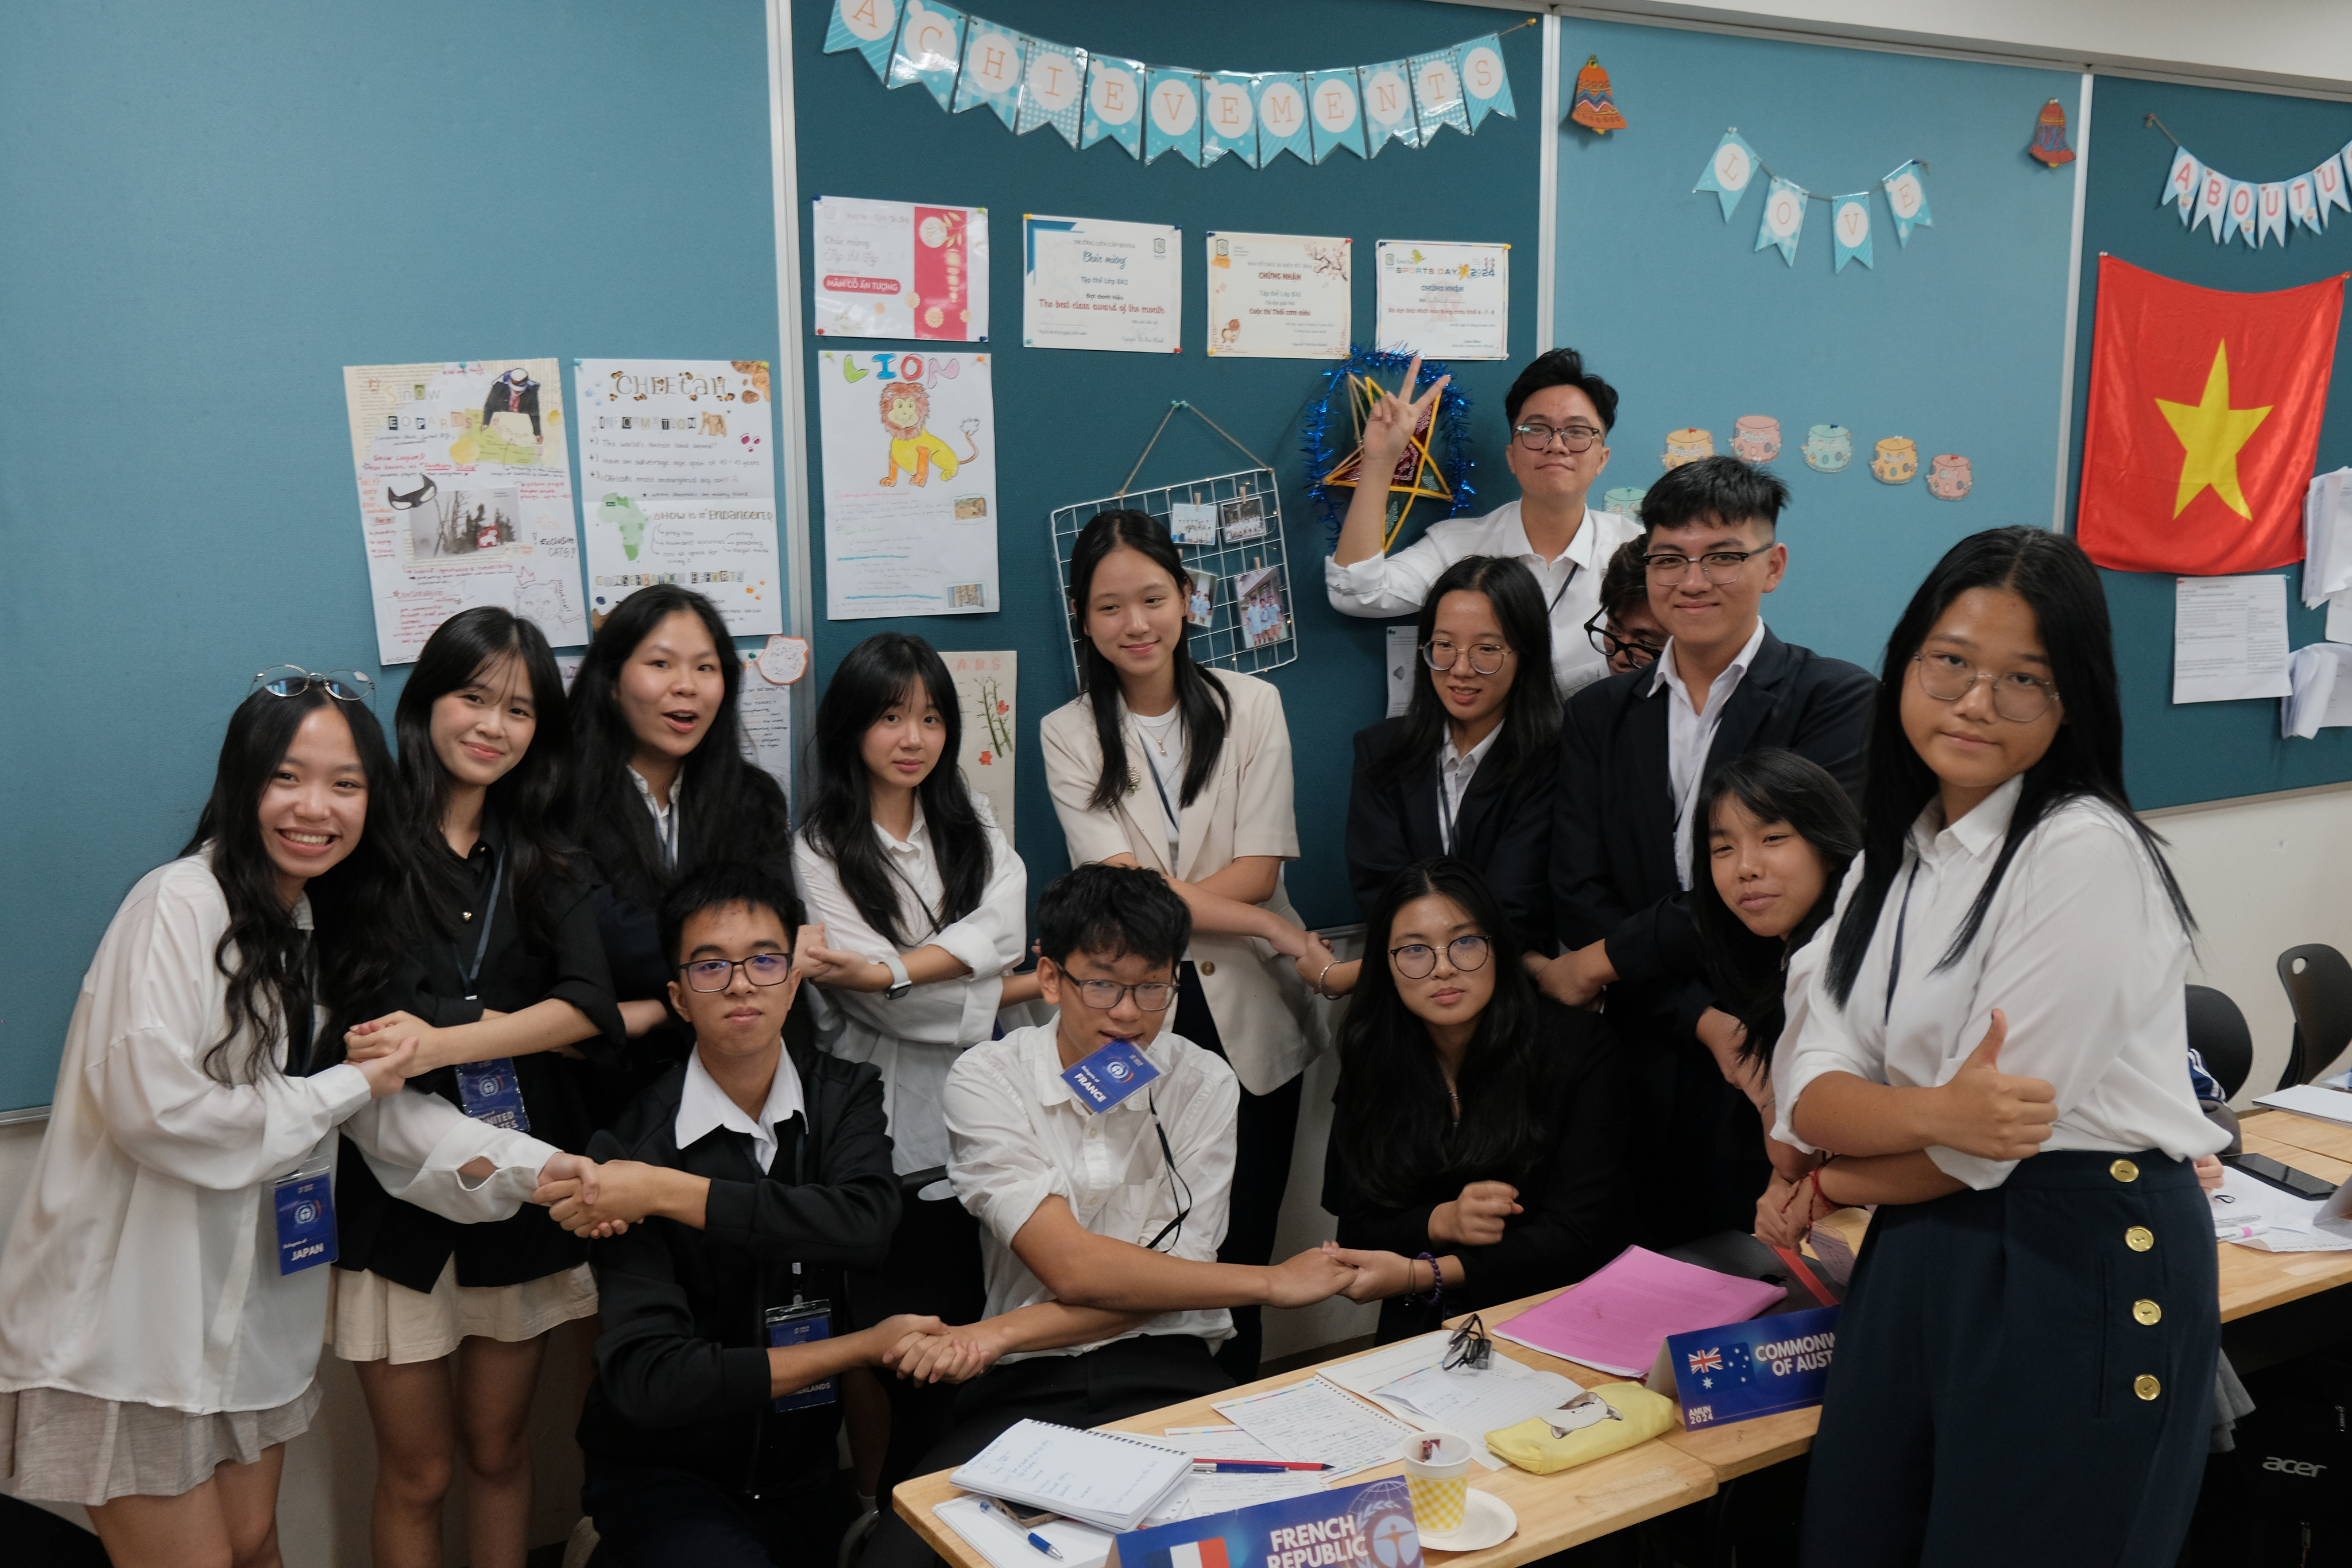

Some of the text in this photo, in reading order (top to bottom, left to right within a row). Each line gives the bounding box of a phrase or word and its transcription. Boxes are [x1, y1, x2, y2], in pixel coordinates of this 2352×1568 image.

[852, 0, 1495, 125] ACHIEVEMENTS
[1722, 153, 1914, 237] LOVE
[1039, 299, 1165, 314] The best class award of the month
[844, 353, 960, 389] LION
[291, 1242, 324, 1261] JAPAN
[1772, 1360, 1793, 1377] OF
[1689, 1405, 1712, 1418] AMUN
[1690, 1413, 1714, 1426] 2024
[2262, 1456, 2328, 1477] acer
[1270, 1515, 1356, 1552] FRENCH
[1267, 1536, 1369, 1568] REPUBLIC
